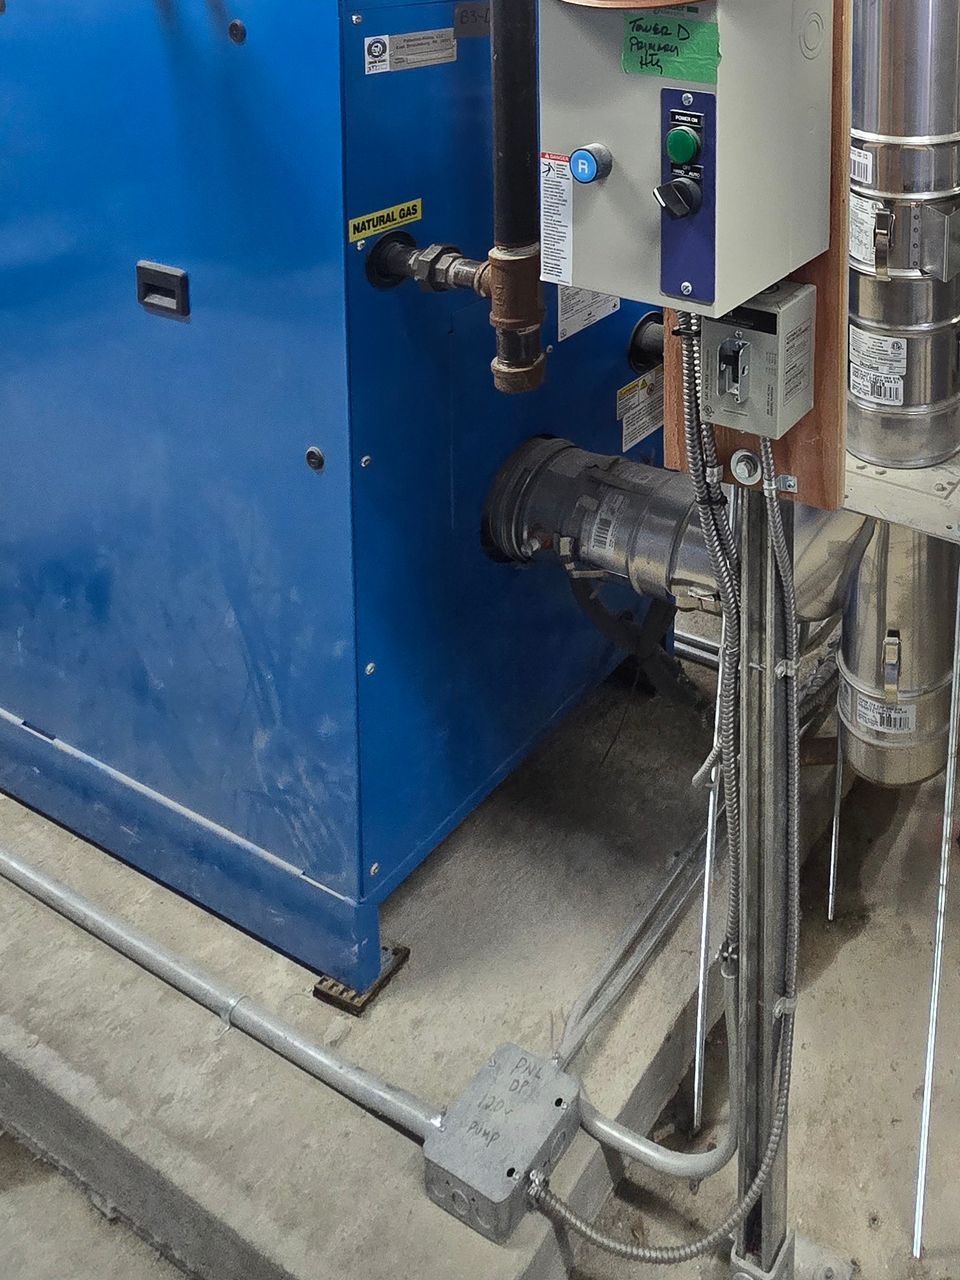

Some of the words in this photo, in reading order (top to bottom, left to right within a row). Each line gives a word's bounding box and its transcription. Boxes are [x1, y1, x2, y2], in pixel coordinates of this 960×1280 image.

[678, 24, 690, 40] D
[578, 159, 588, 174] R
[353, 211, 397, 235] NATURAL
[399, 204, 418, 219] GAS
[511, 1057, 542, 1080] PNL
